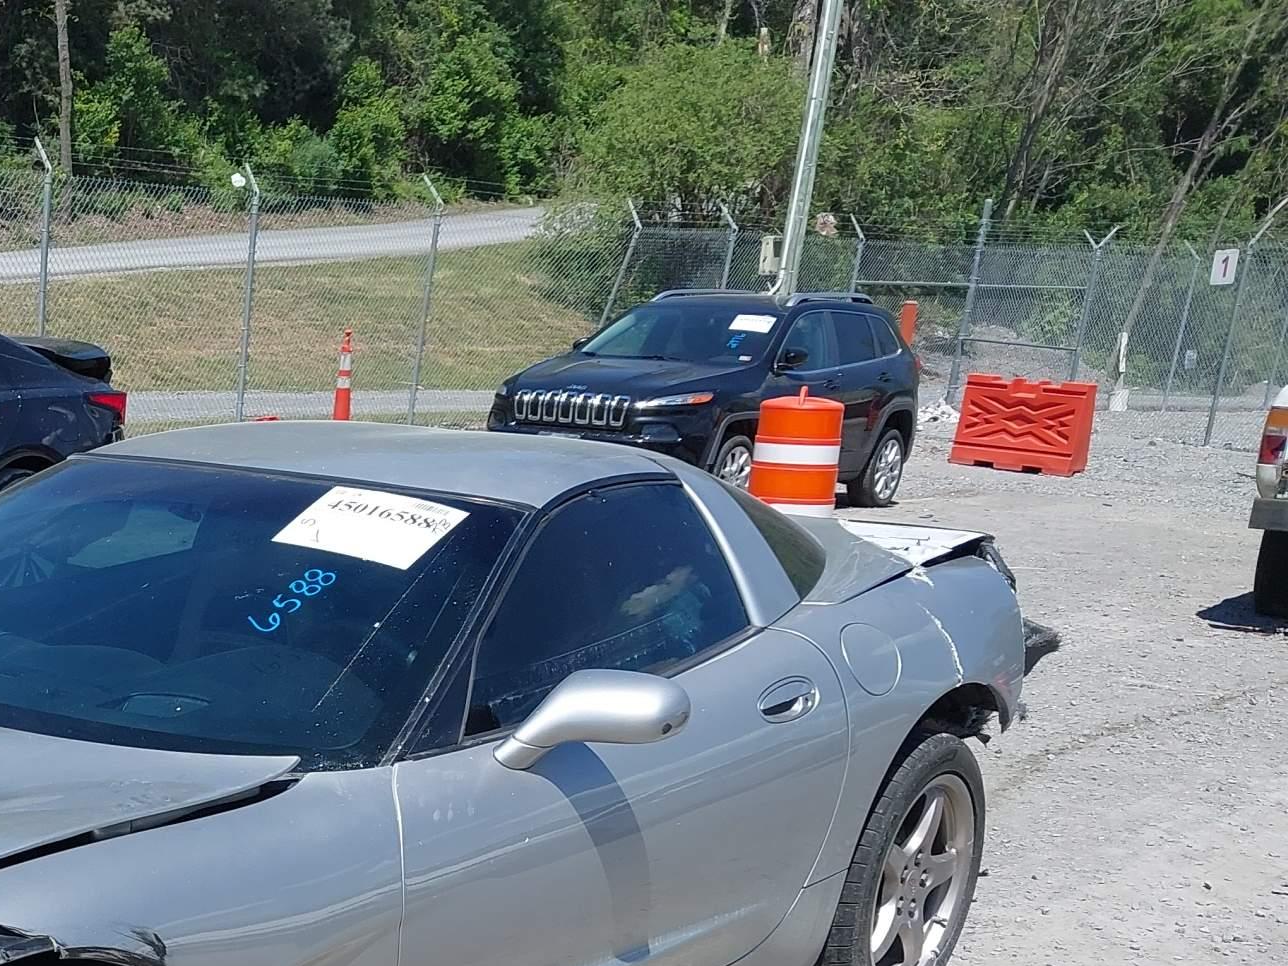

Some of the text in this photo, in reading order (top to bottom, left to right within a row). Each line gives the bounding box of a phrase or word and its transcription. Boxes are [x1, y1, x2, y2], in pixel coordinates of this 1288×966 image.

[1221, 255, 1230, 279] 1
[327, 499, 436, 529] 45016588
[247, 568, 336, 632] 6588
